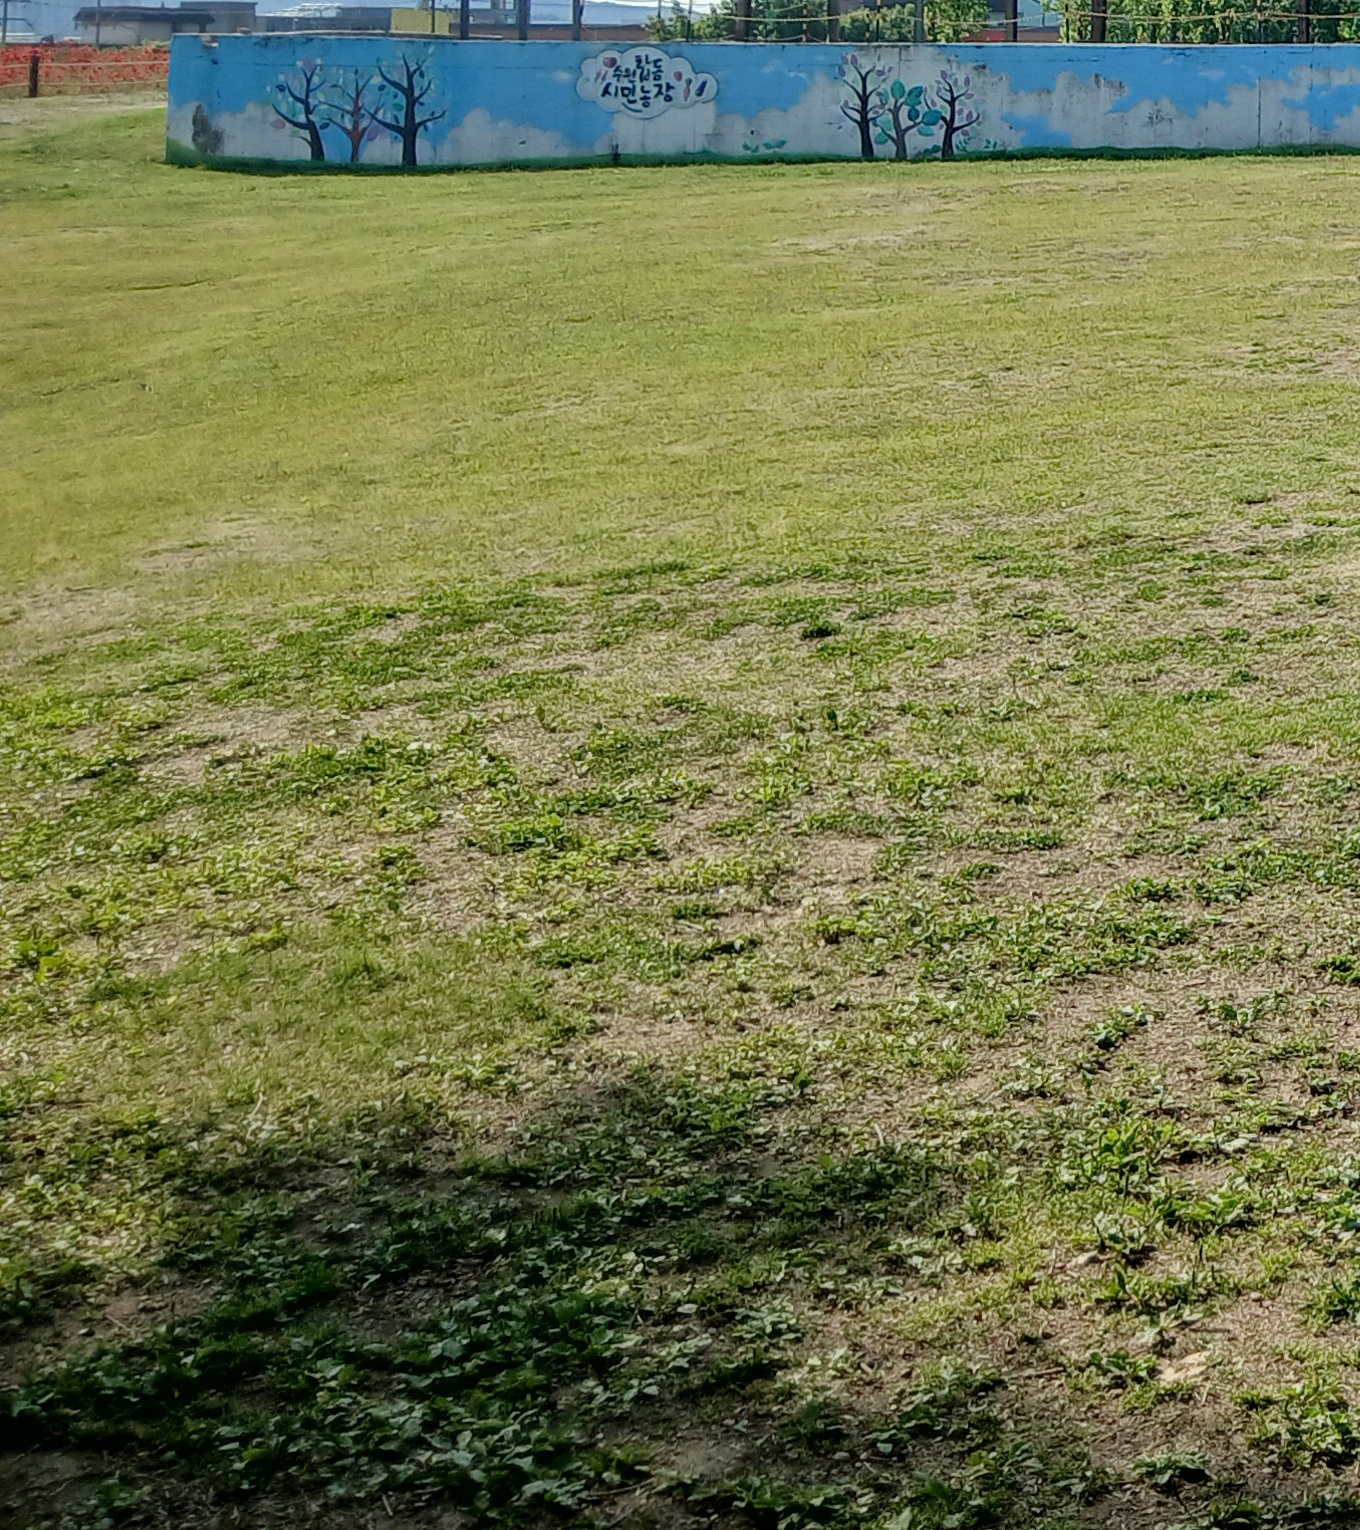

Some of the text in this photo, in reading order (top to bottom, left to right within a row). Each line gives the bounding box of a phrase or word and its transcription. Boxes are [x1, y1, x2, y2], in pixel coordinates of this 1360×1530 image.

[612, 54, 664, 83] 수원 탑동
[601, 82, 675, 108] 시민농장
